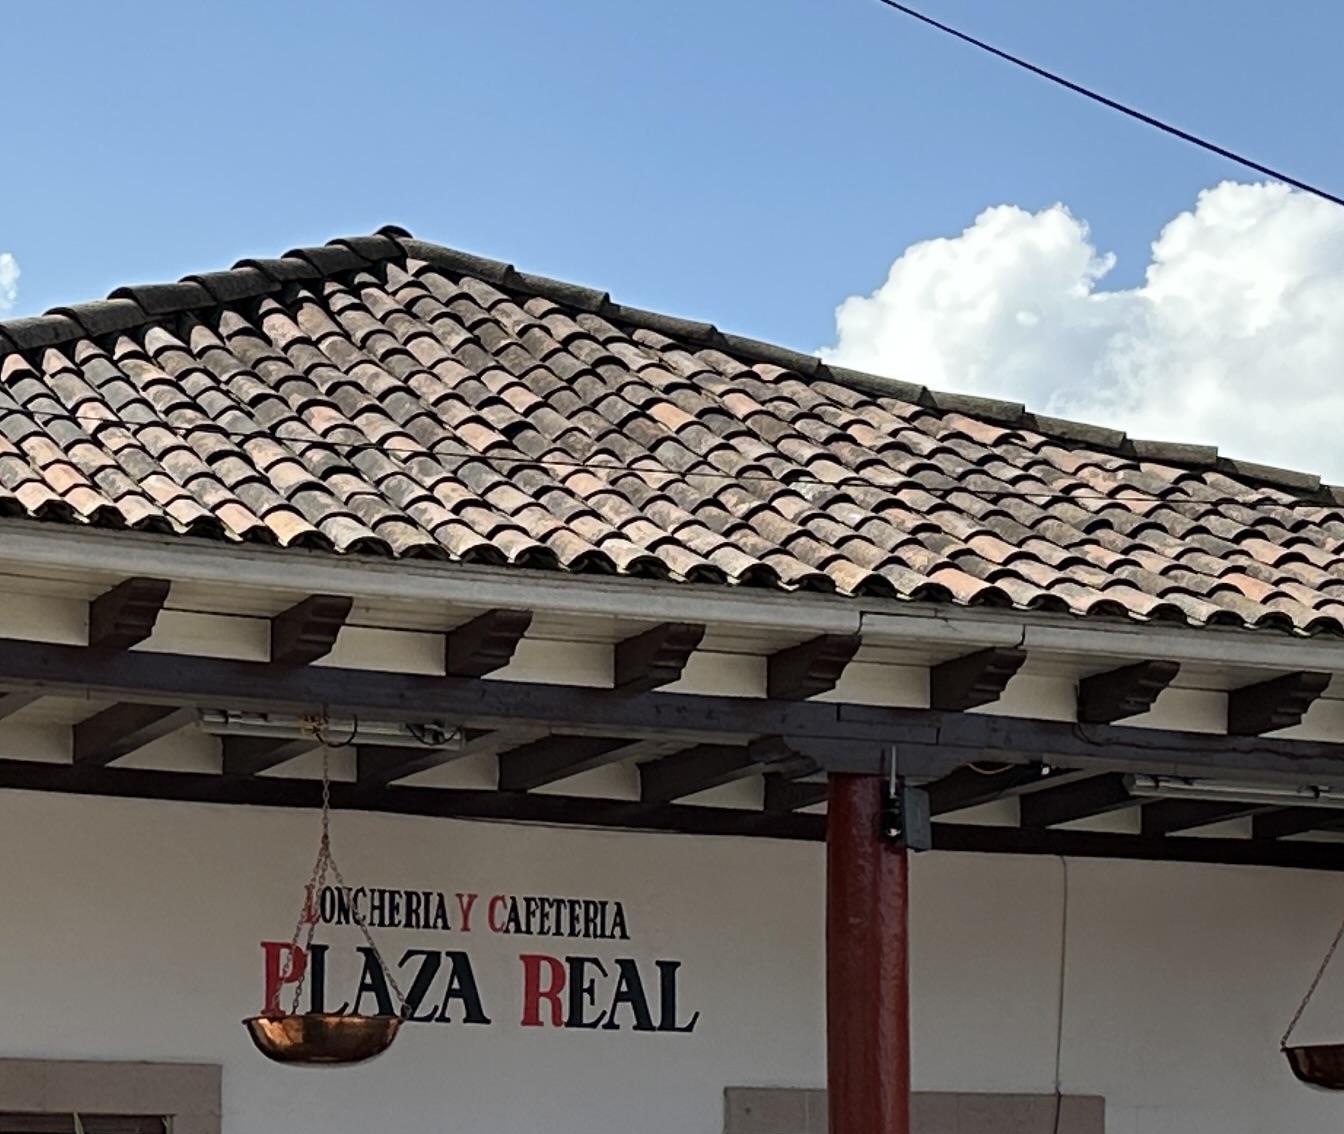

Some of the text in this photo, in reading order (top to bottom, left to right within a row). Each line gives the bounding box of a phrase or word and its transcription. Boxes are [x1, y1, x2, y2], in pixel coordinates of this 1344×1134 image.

[304, 884, 630, 940] LONCHERIA Y CAFETERIA
[261, 941, 701, 1034] PLAZA REAL
